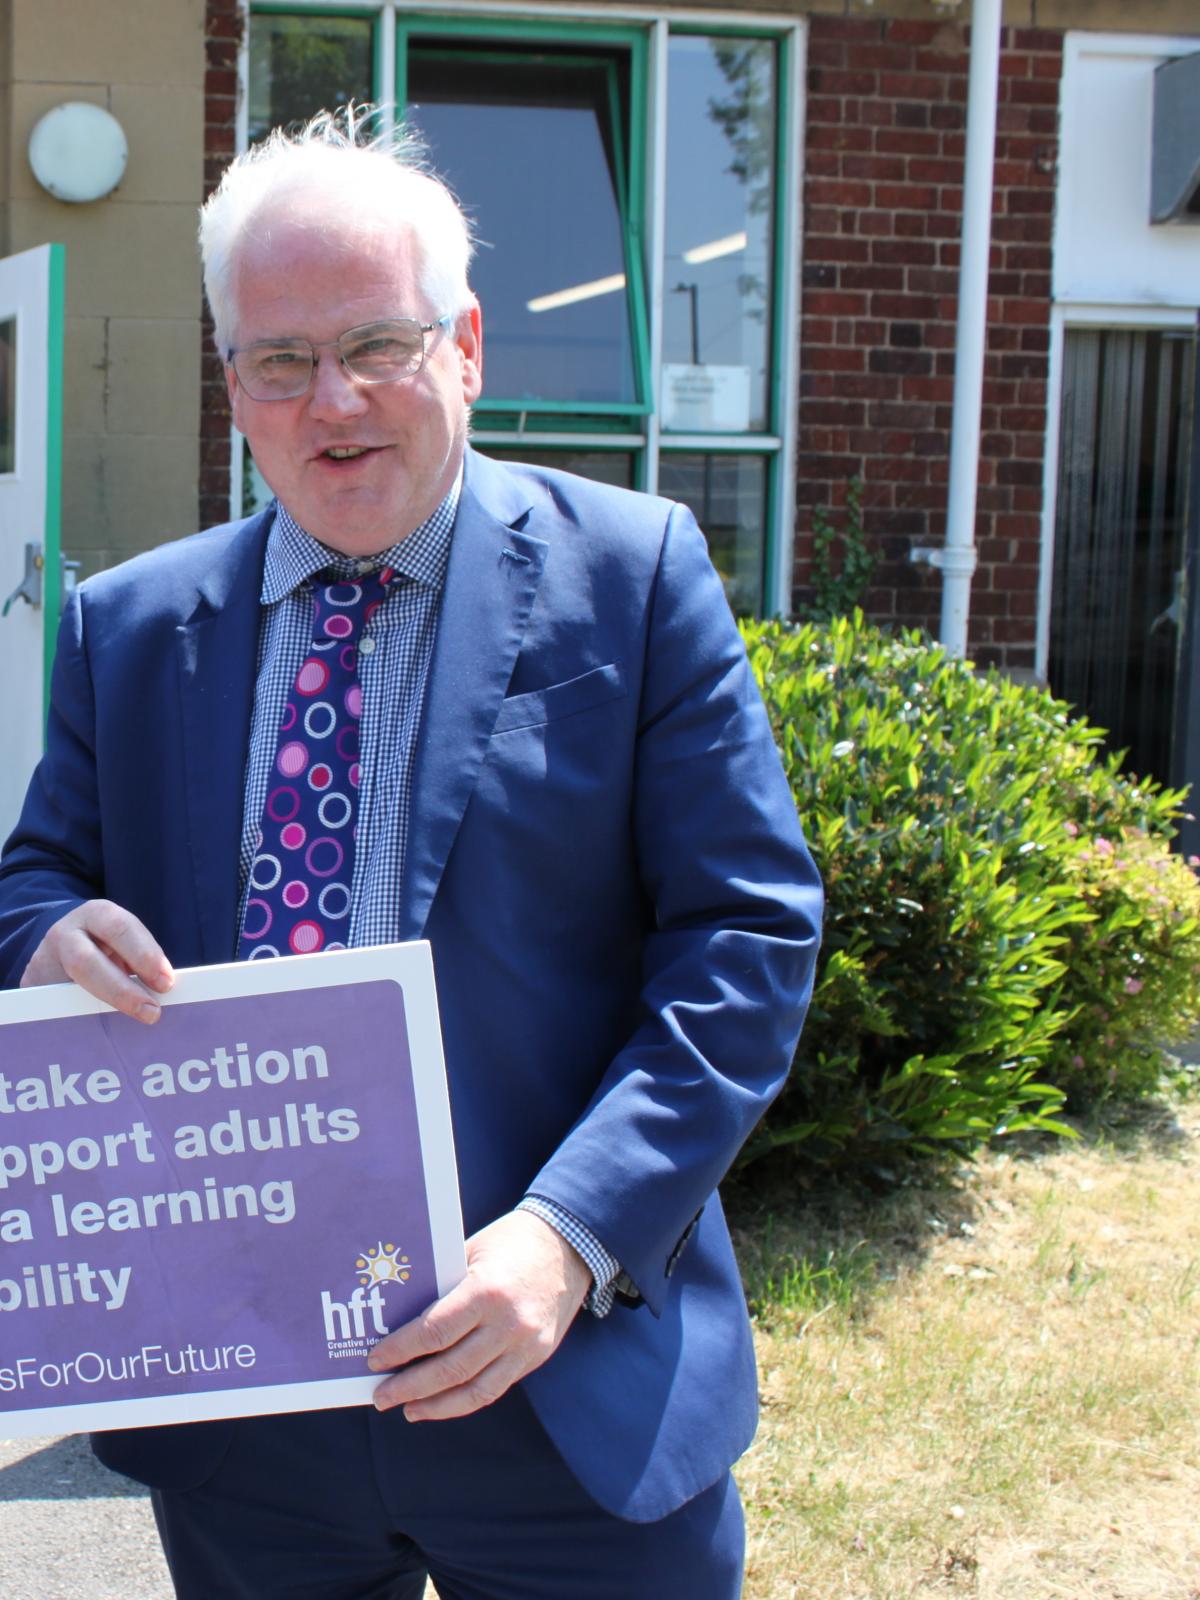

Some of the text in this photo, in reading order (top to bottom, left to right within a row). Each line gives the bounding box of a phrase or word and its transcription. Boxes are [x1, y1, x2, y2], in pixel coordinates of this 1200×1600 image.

[141, 1043, 329, 1098] action
[173, 1103, 361, 1159] adults
[0, 1209, 34, 1243] a
[51, 1177, 296, 1236] learning
[320, 1286, 389, 1341] hft
[327, 1337, 383, 1349] Creative Ide
[328, 1348, 368, 1359] Fulfilling
